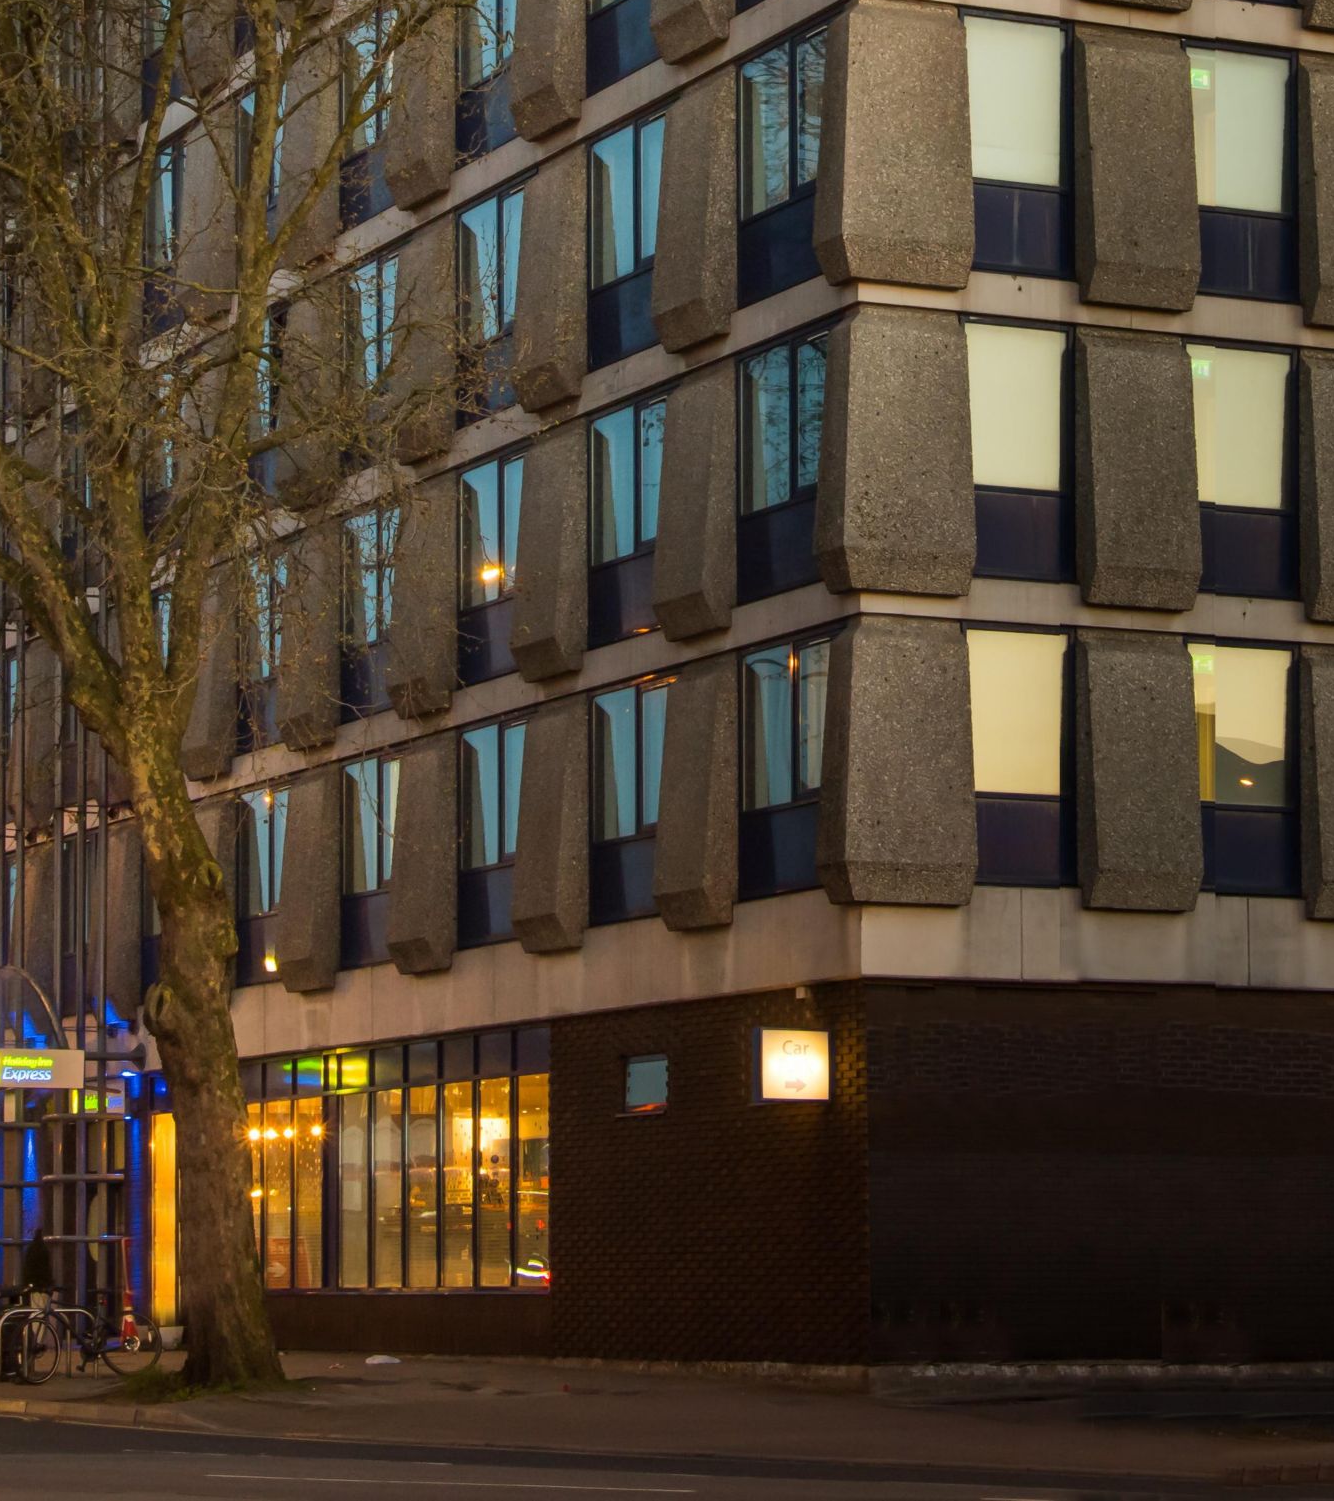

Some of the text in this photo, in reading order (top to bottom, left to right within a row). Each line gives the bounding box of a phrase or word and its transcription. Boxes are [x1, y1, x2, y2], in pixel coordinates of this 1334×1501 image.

[782, 1039, 810, 1056] Car
[3, 1056, 54, 1068] Holiday Inn
[2, 1067, 52, 1083] Express
